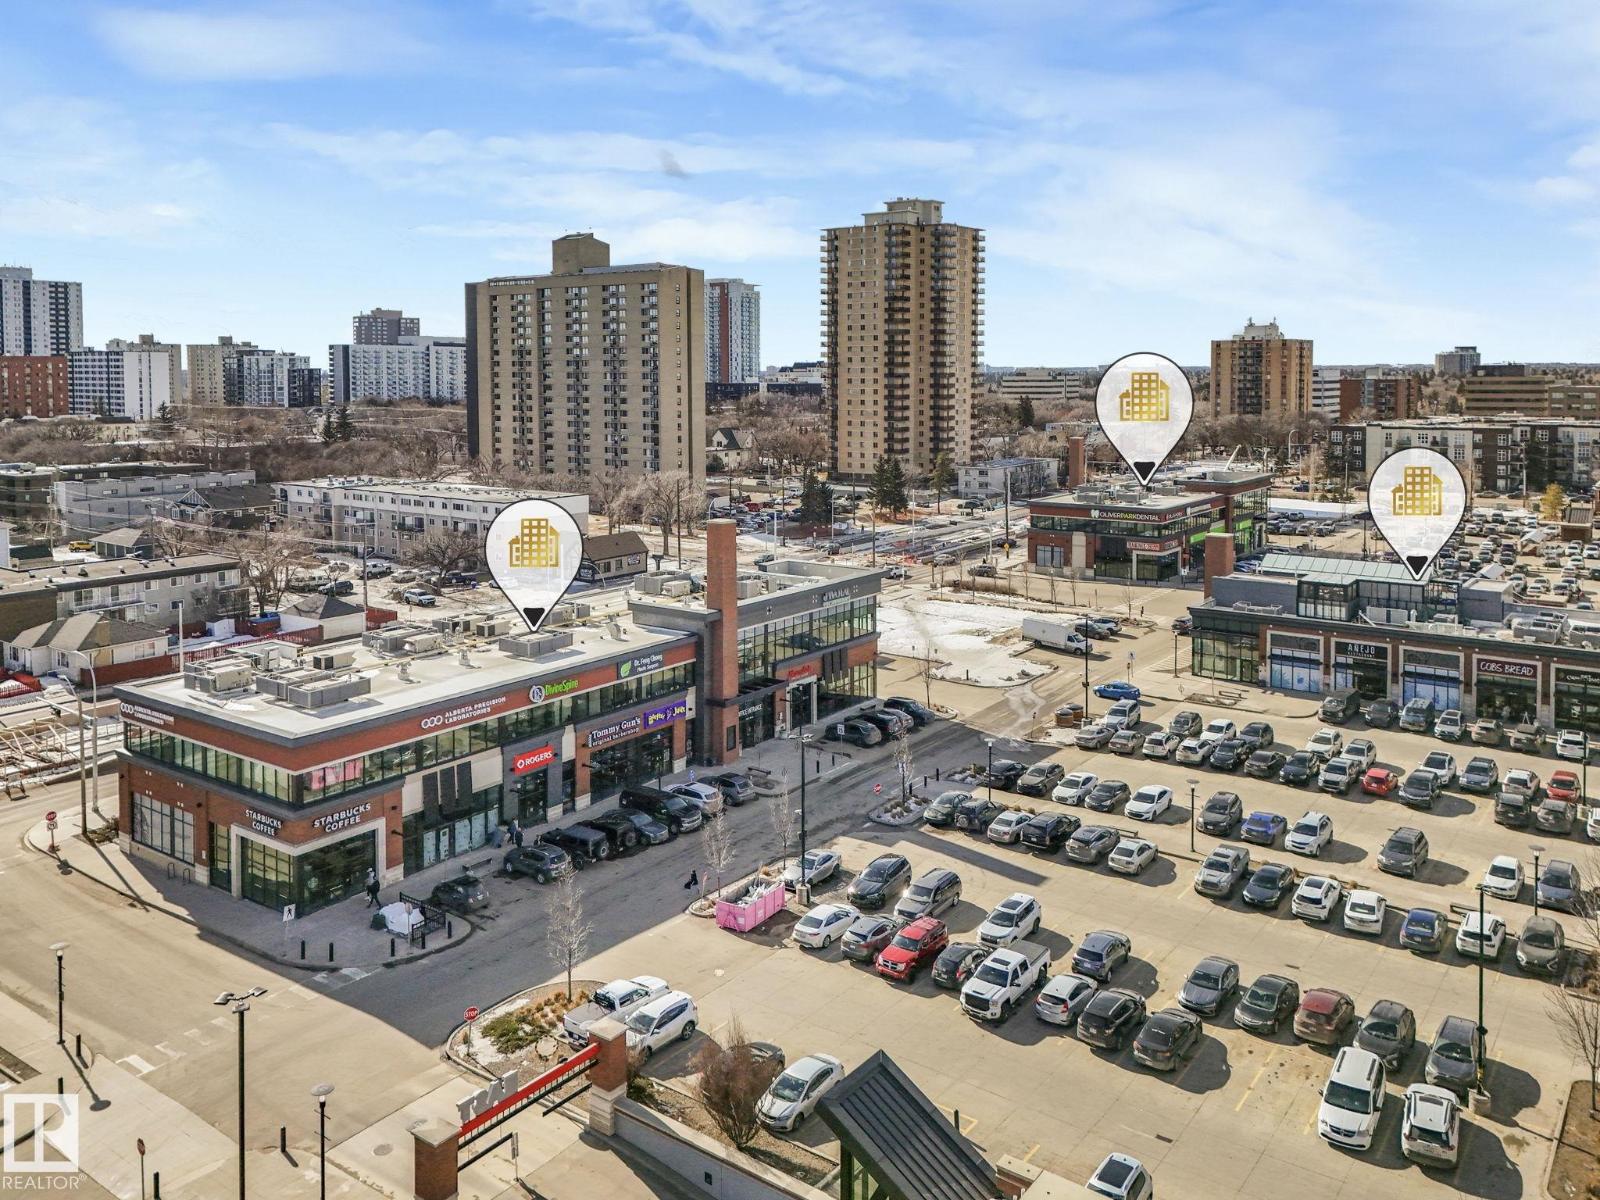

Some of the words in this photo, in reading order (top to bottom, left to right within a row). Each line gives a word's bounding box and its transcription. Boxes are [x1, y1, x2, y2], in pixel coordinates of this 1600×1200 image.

[1480, 661, 1502, 672] COBS
[1504, 665, 1534, 676] BREAD
[445, 706, 473, 718] ALBERTA
[474, 696, 506, 710] PRECISION
[445, 707, 491, 724] LABORATORIES
[592, 724, 621, 739] Tommy
[621, 716, 641, 729] Gun's
[525, 750, 553, 766] ROGERS
[245, 809, 281, 829] STARBUCKS
[313, 802, 371, 828] STARBUCKS
[252, 821, 275, 836] COFFEE
[325, 815, 360, 833] COFFEE
[465, 1010, 478, 1018] STOP
